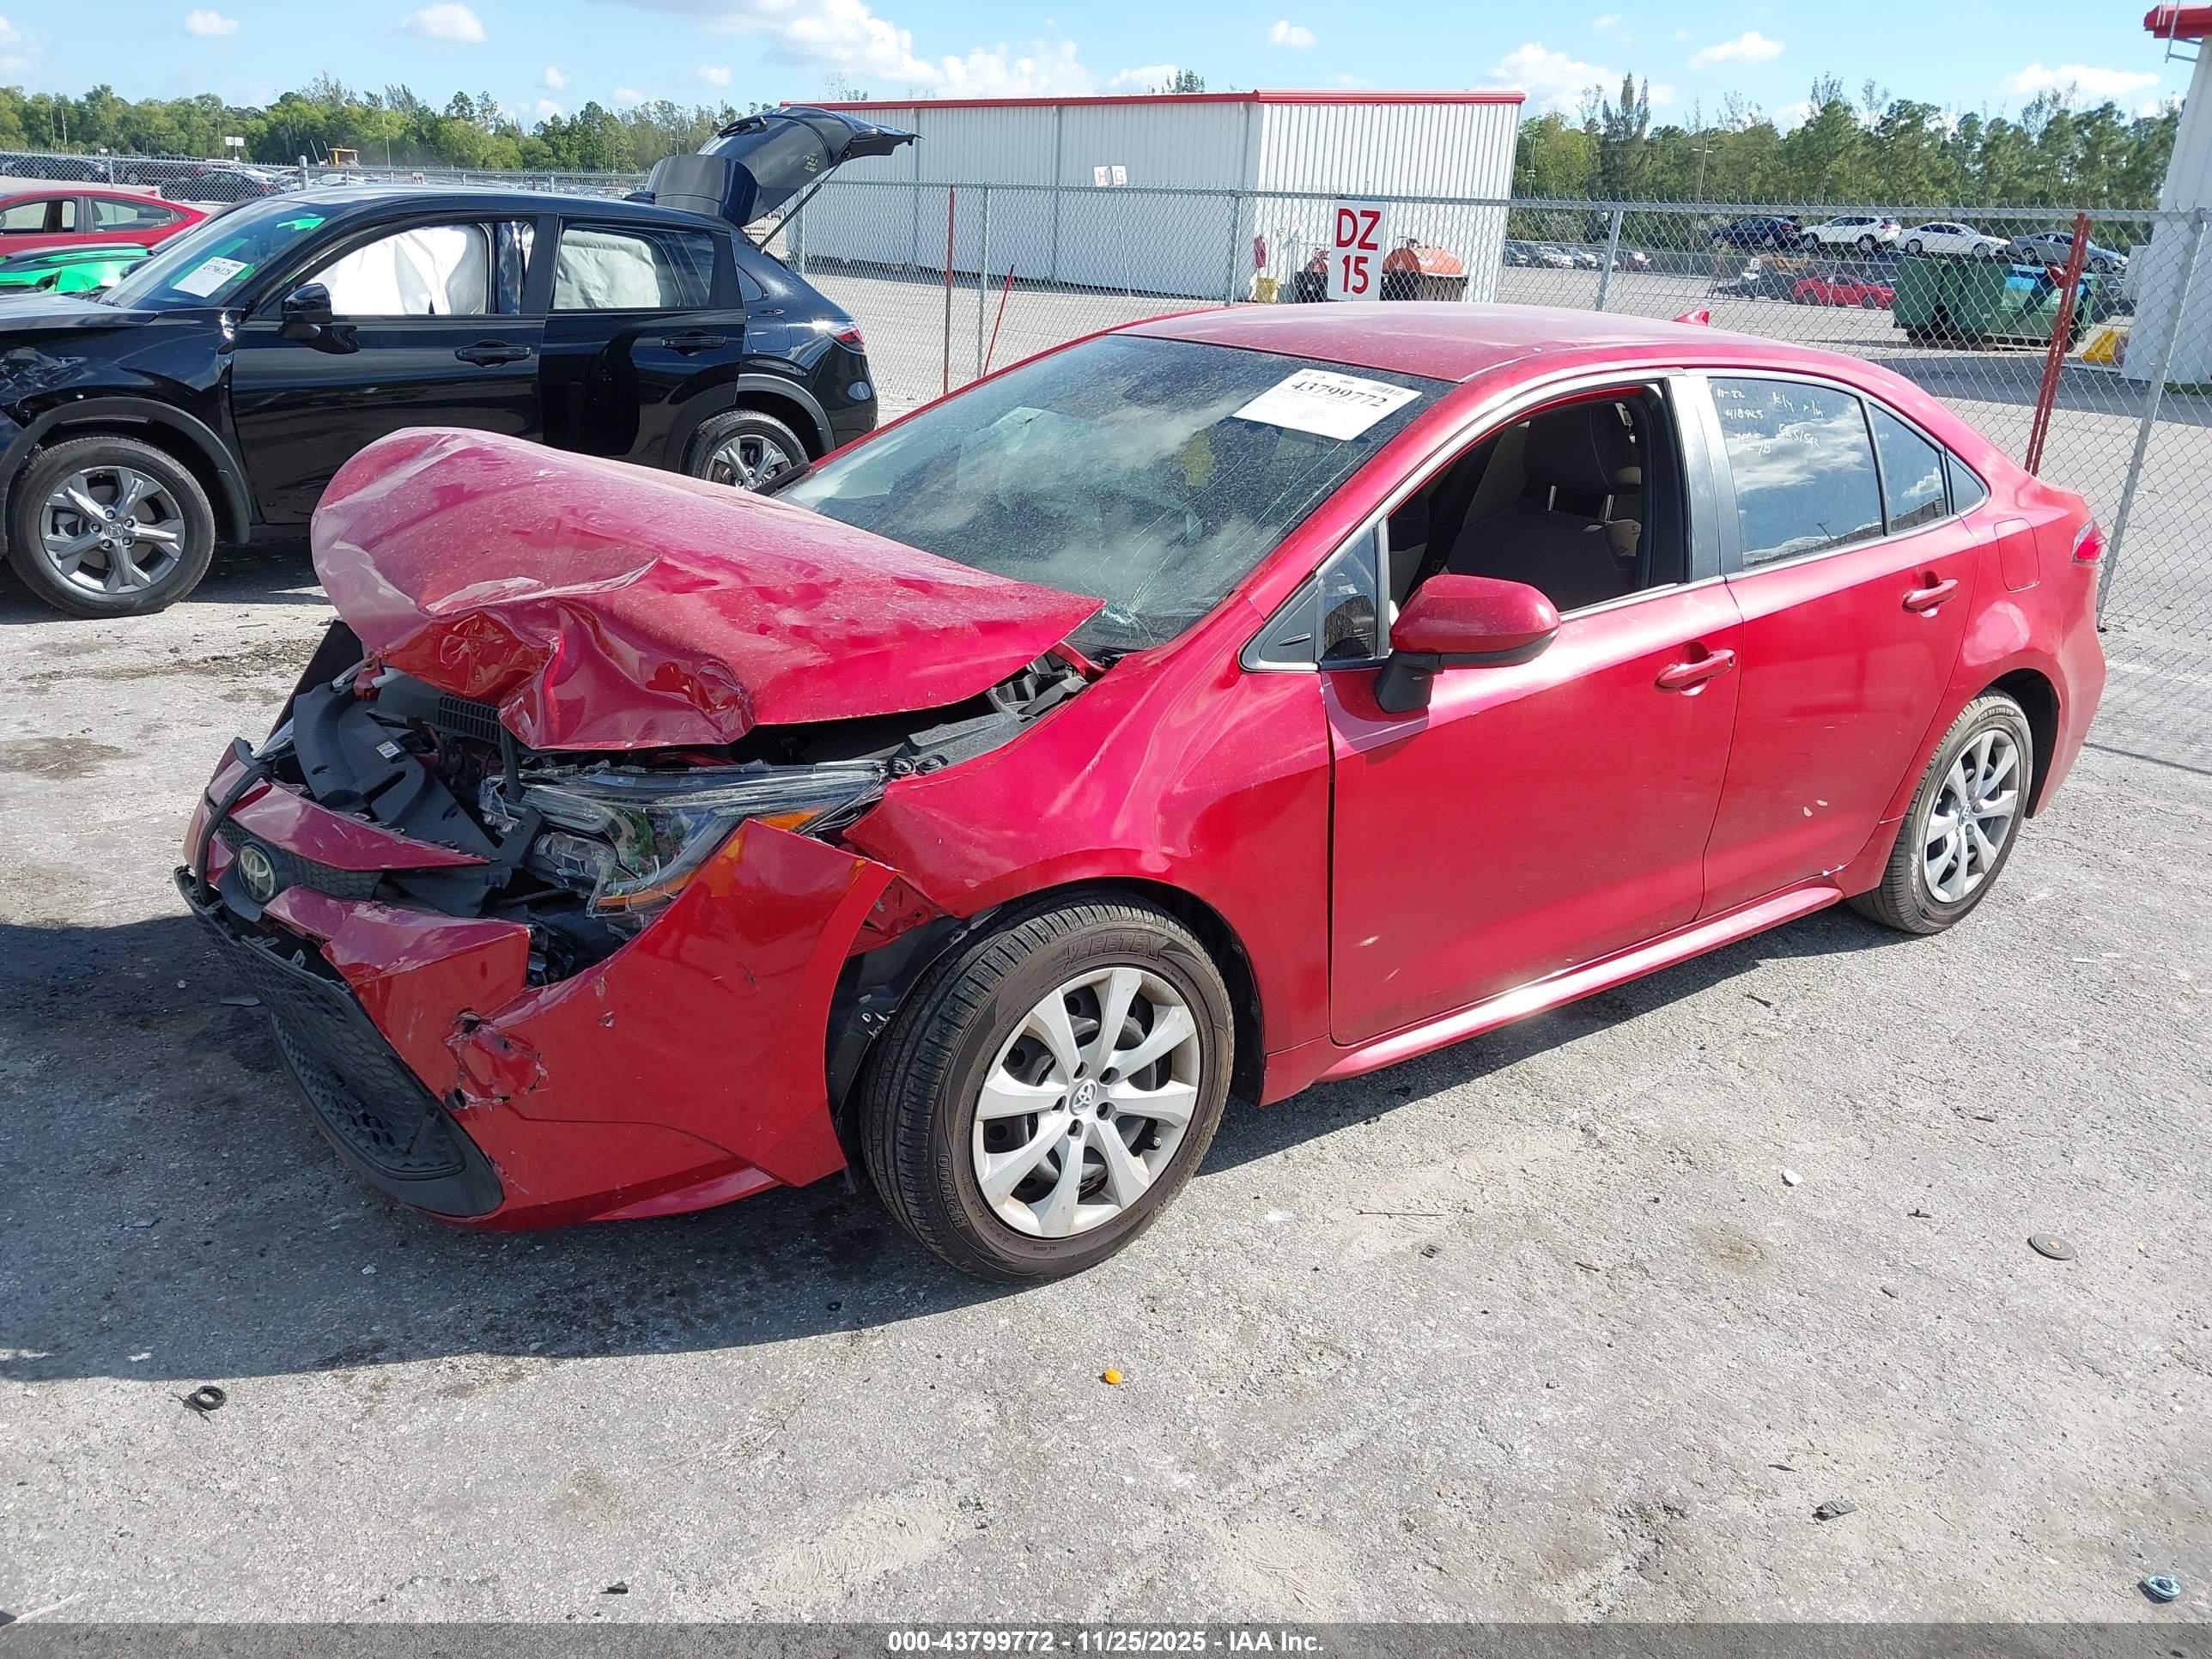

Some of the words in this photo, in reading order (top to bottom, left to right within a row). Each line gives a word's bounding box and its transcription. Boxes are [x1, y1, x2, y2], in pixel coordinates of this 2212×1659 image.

[1336, 208, 1381, 251] DZ
[1341, 254, 1369, 295] 15
[1291, 380, 1388, 407] 43799772
